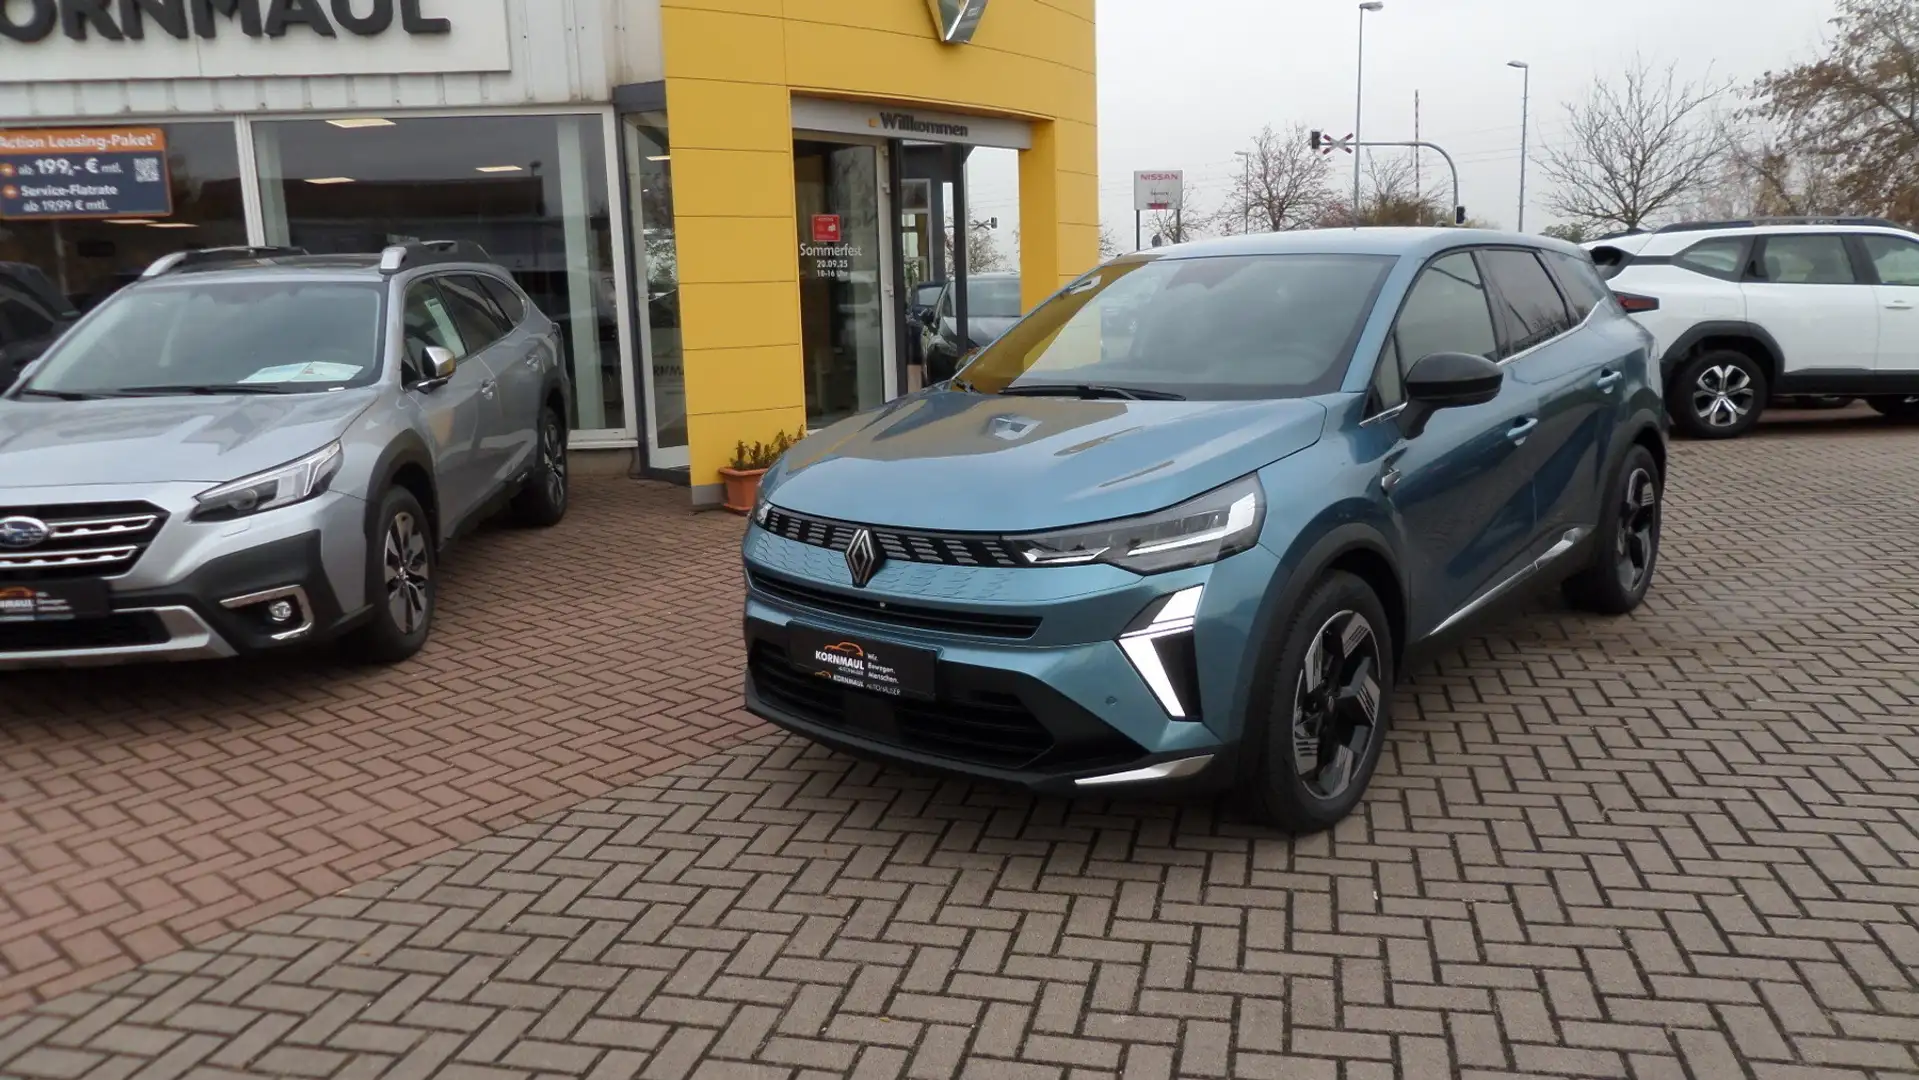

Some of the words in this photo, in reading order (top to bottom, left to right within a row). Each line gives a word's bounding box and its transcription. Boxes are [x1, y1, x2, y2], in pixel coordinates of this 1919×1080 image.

[879, 112, 968, 137] Willkommen
[18, 164, 34, 176] ab
[85, 157, 98, 174] €
[101, 162, 123, 174] mtl.
[1140, 173, 1178, 181] NISSAN
[21, 185, 118, 197] Service-Flatrate
[23, 201, 39, 212] ab
[74, 200, 84, 211] €
[85, 199, 110, 211] mtl.
[800, 243, 862, 256] Sommerfest
[816, 260, 848, 268] 20.09.25
[815, 650, 865, 670] KORNMAUL
[833, 674, 864, 688] KORNMAUL
[868, 672, 899, 683] Menschen.
